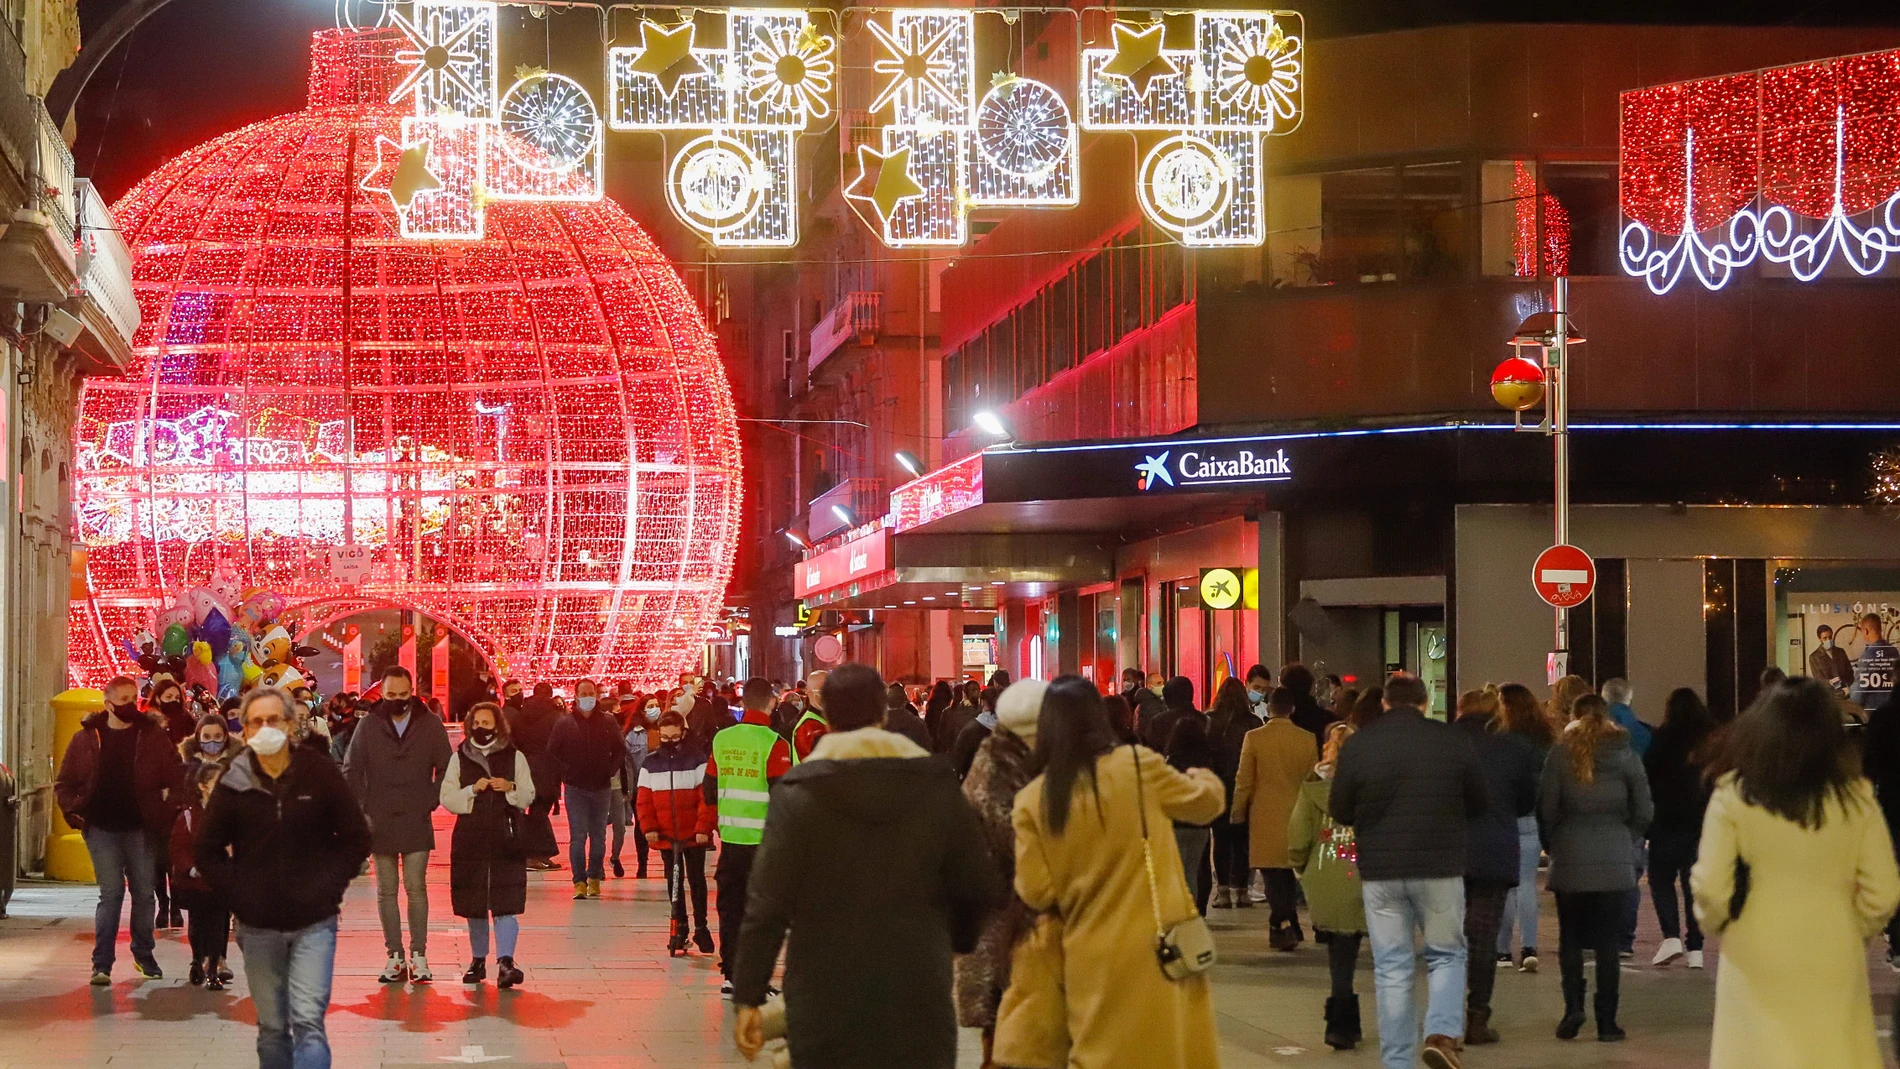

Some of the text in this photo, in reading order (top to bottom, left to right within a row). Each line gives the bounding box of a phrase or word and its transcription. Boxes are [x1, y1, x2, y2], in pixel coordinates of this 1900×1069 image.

[1179, 449, 1291, 478] CaixaBank
[337, 547, 364, 558] VIGO
[1860, 672, 1881, 688] 50
